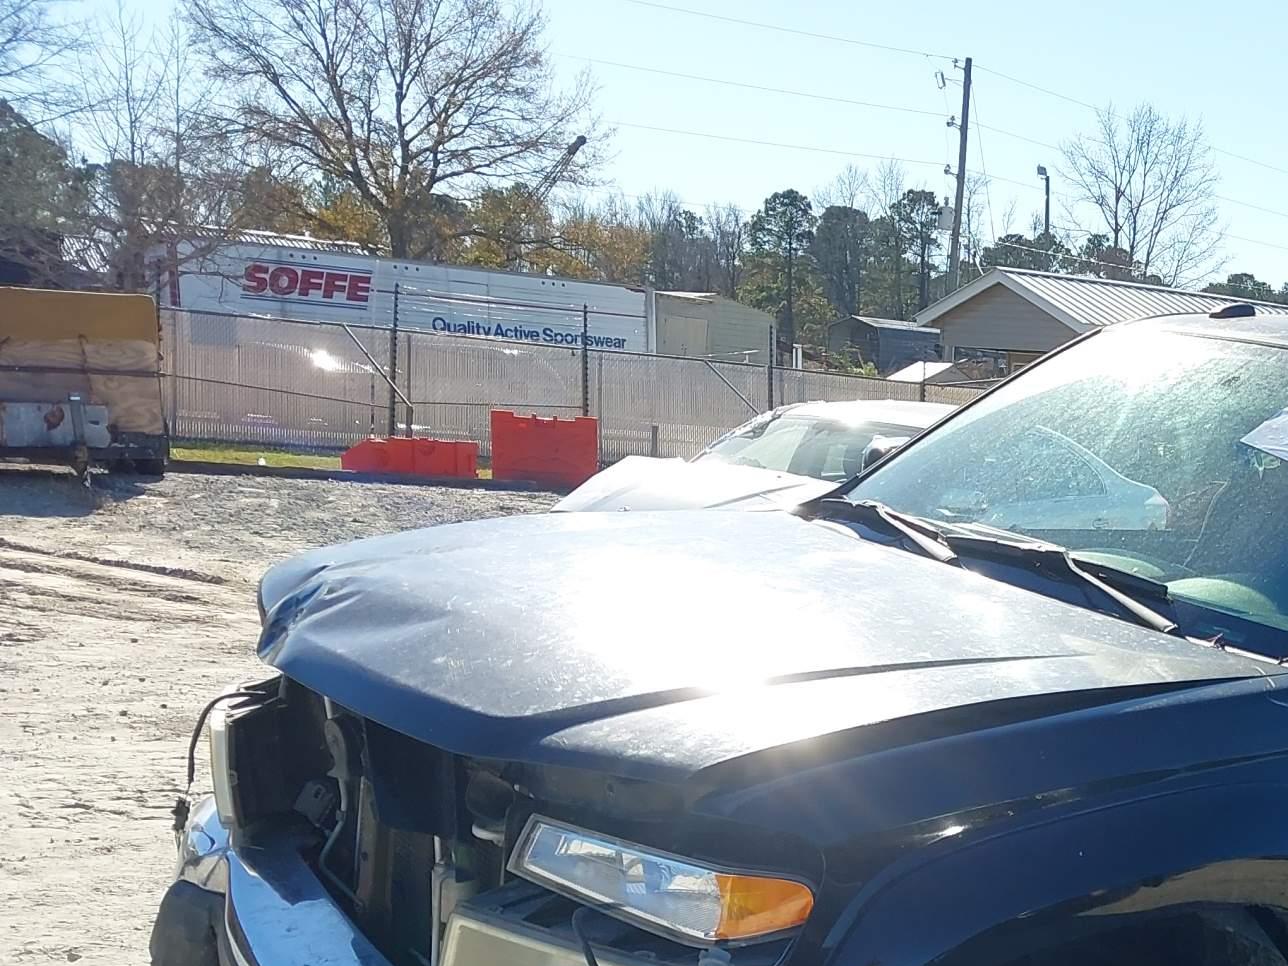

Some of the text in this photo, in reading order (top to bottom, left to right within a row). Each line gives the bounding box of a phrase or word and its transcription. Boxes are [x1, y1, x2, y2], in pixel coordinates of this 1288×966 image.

[242, 263, 371, 302] SOFFE
[431, 316, 627, 349] Quality Active Sportswear
